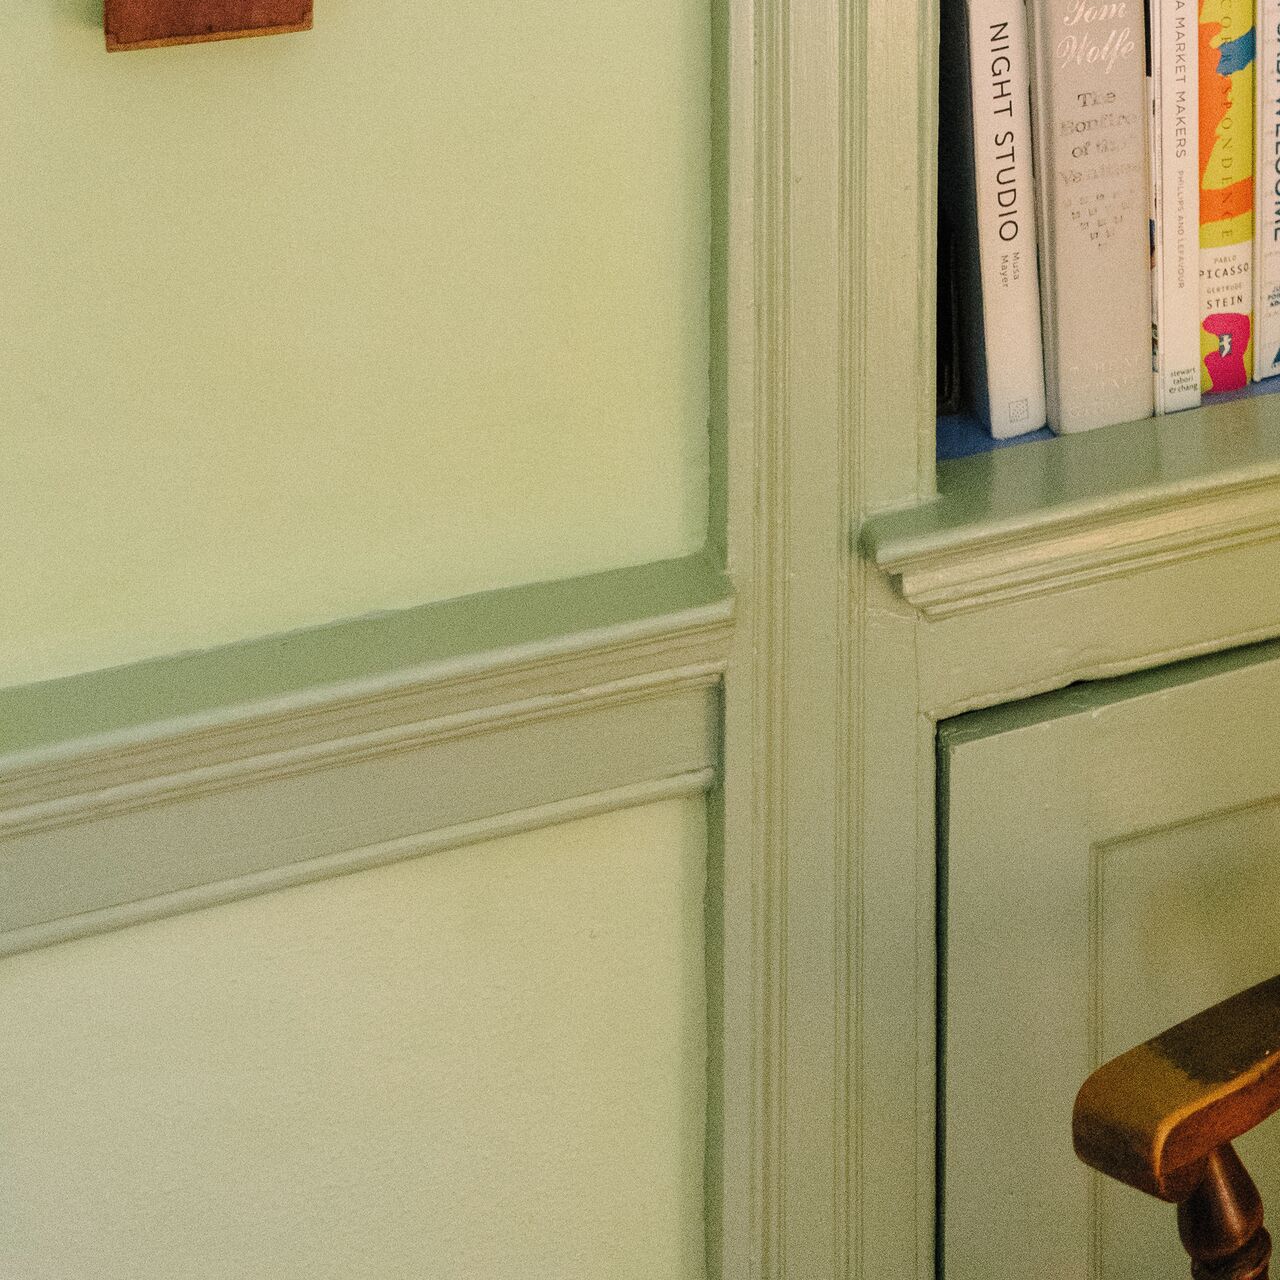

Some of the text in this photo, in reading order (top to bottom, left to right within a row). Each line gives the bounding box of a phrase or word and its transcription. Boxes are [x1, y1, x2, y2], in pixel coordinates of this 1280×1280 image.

[1057, 27, 1135, 74] Wolfe
[1175, 17, 1187, 84] MARKET
[989, 22, 1019, 242] NIGHT STUDIO
[1176, 93, 1187, 159] MAKERS
[1177, 170, 1185, 212] PHILLIPS
[1177, 215, 1185, 236] AND
[1000, 254, 1009, 288] Mayer
[1012, 251, 1020, 281] Musa
[1199, 262, 1249, 279] PICASSO
[1207, 295, 1243, 310] STEIN
[1170, 366, 1196, 378] stewart
